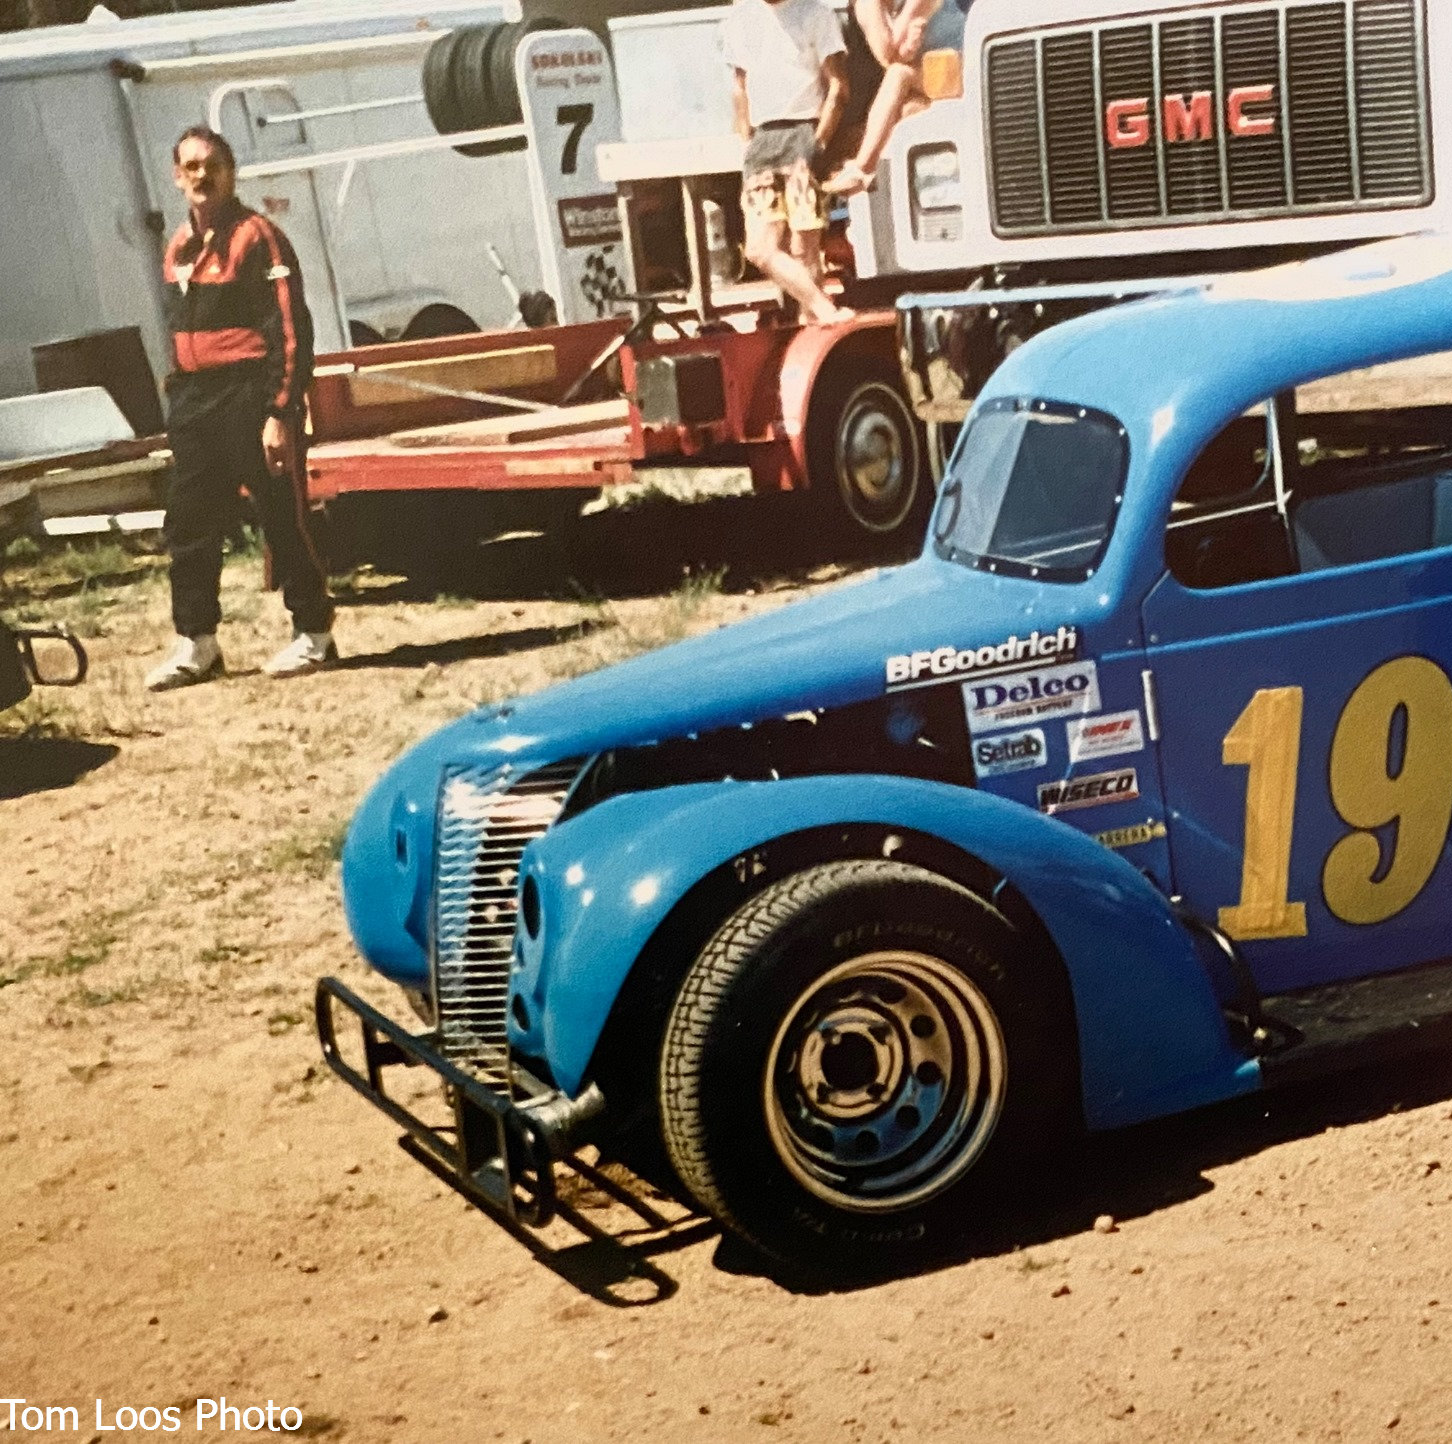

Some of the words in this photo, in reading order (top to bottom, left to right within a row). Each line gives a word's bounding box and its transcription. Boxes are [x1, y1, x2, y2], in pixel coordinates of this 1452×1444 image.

[556, 102, 595, 175] 7
[1106, 84, 1275, 148] GMC
[886, 625, 1077, 684] BFGoodrich
[971, 674, 1090, 710] Delco
